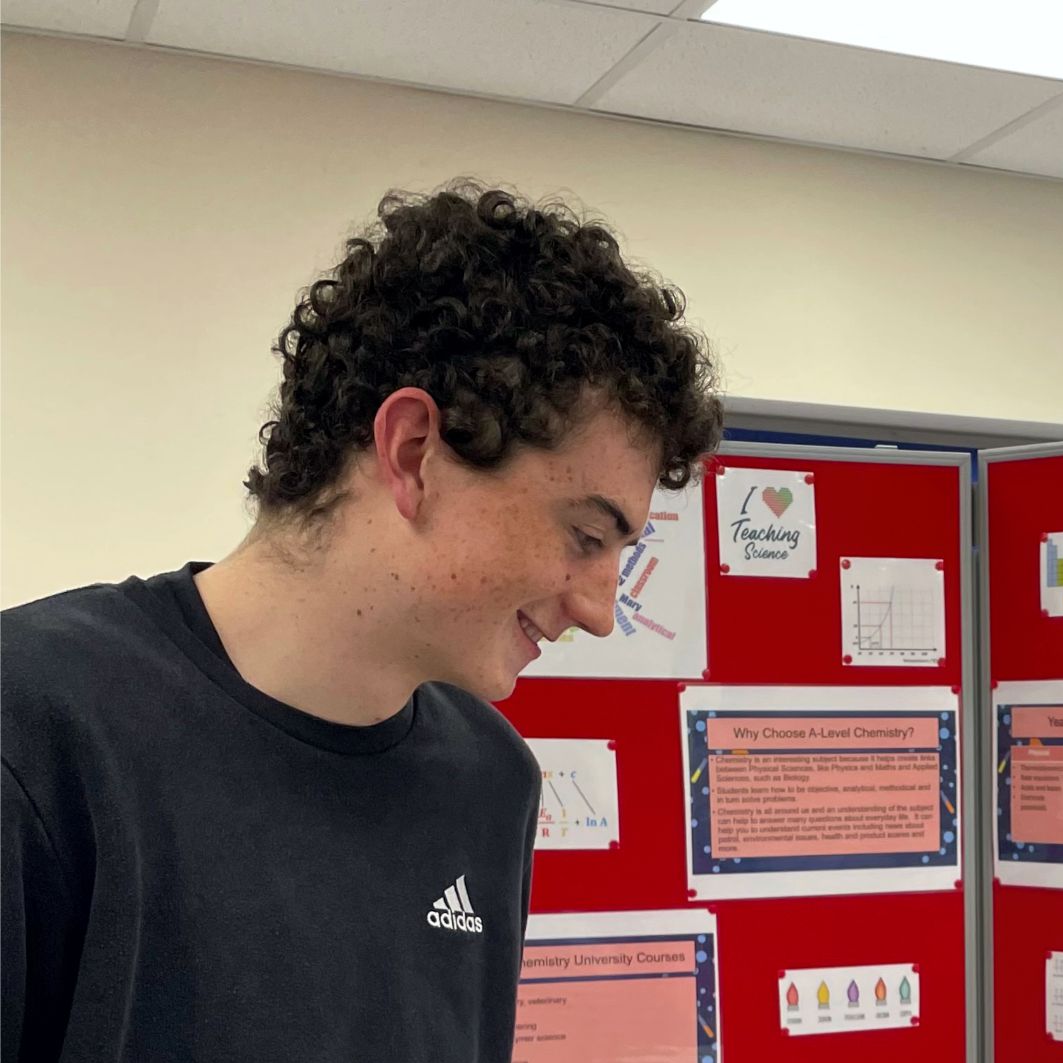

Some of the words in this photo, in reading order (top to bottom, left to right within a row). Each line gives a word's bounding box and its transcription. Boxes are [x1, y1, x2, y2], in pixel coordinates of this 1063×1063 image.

[740, 486, 758, 514] I
[730, 518, 800, 550] Teaching
[744, 541, 789, 560] Science
[618, 593, 642, 612] Mary
[615, 602, 636, 637] ment
[733, 728, 759, 741] Why
[762, 728, 806, 739] Choose
[808, 727, 850, 738] A-Level
[854, 726, 914, 740] Chemistry?
[427, 909, 483, 932] adidas
[520, 955, 570, 968] emistry
[574, 954, 634, 966] University
[636, 952, 686, 963] Courses
